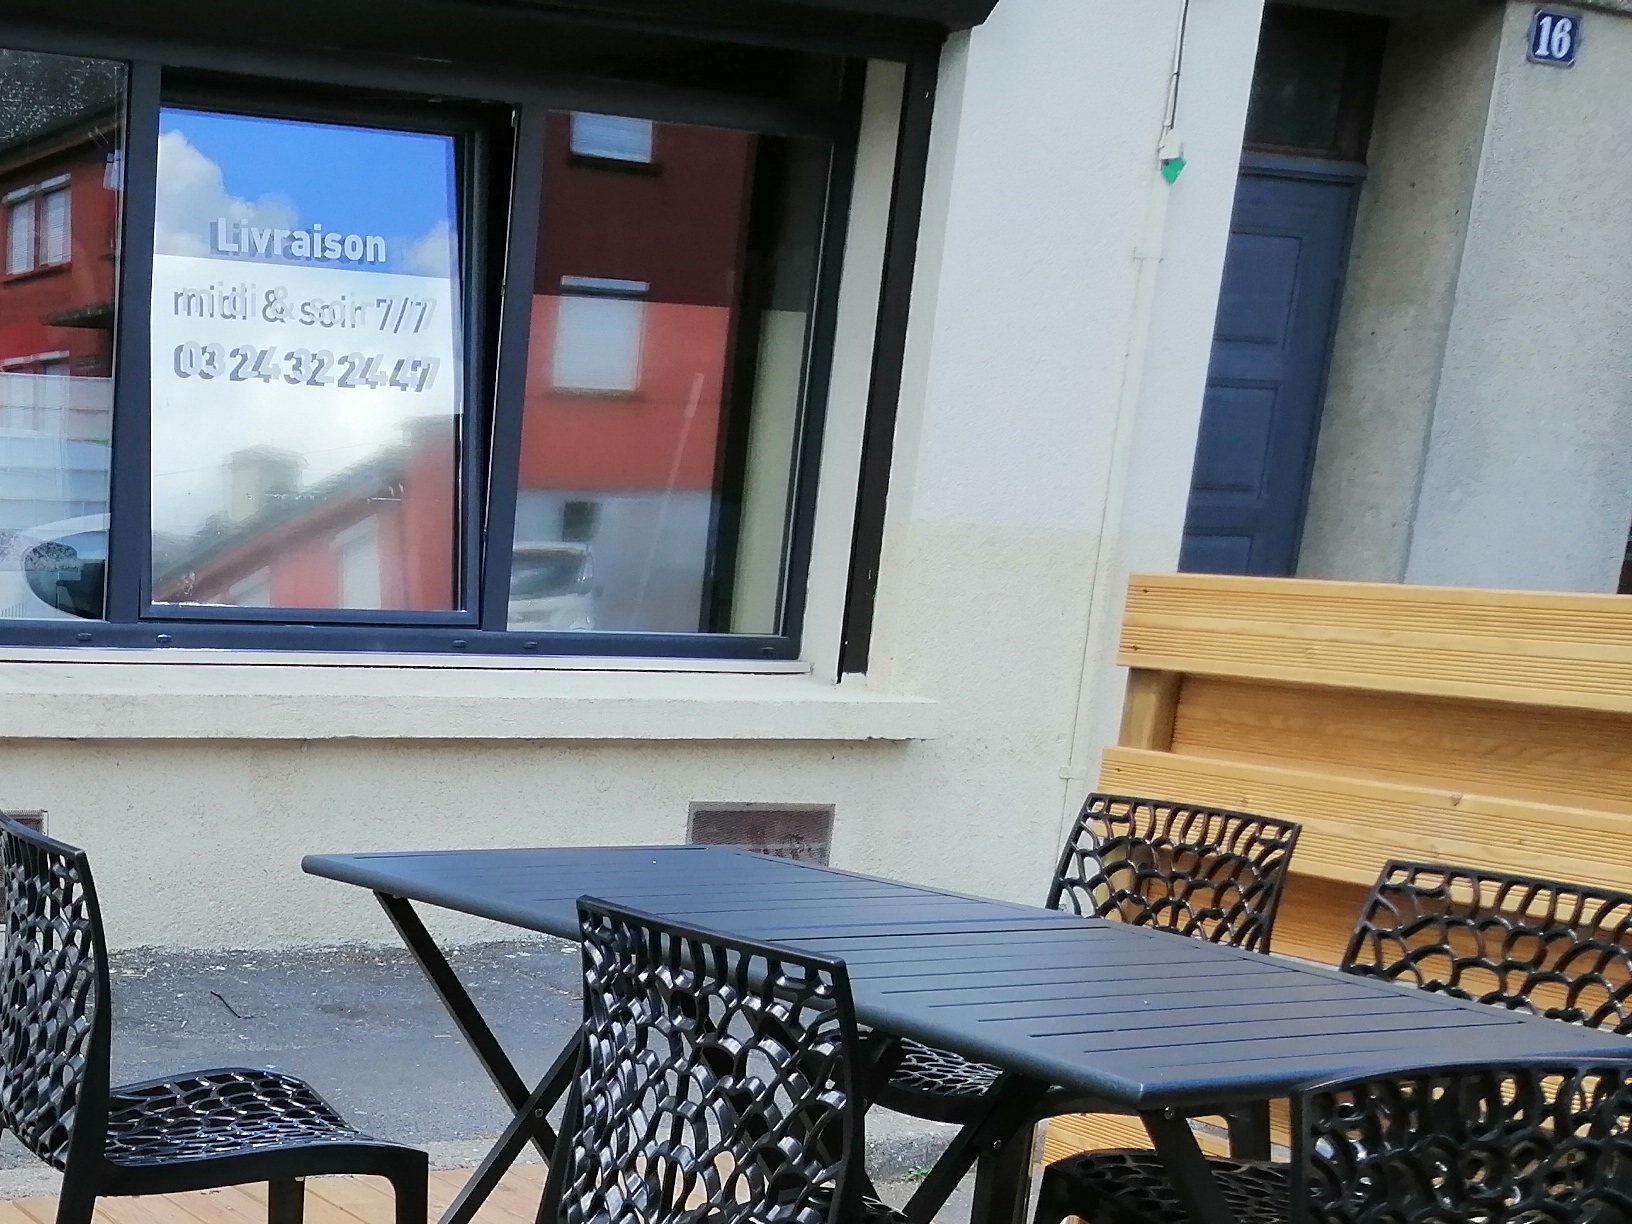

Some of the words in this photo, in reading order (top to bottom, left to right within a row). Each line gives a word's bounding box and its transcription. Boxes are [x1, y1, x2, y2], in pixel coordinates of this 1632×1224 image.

[1534, 16, 1572, 59] 16
[211, 217, 386, 264] Livraison
[175, 282, 257, 320] midi
[263, 285, 295, 323] &
[300, 292, 375, 328] soir
[377, 297, 438, 333] 7/7
[175, 341, 226, 379] 03
[230, 345, 282, 383] 24
[284, 348, 335, 386] 32
[338, 352, 389, 389] 24
[390, 355, 441, 392] 47
